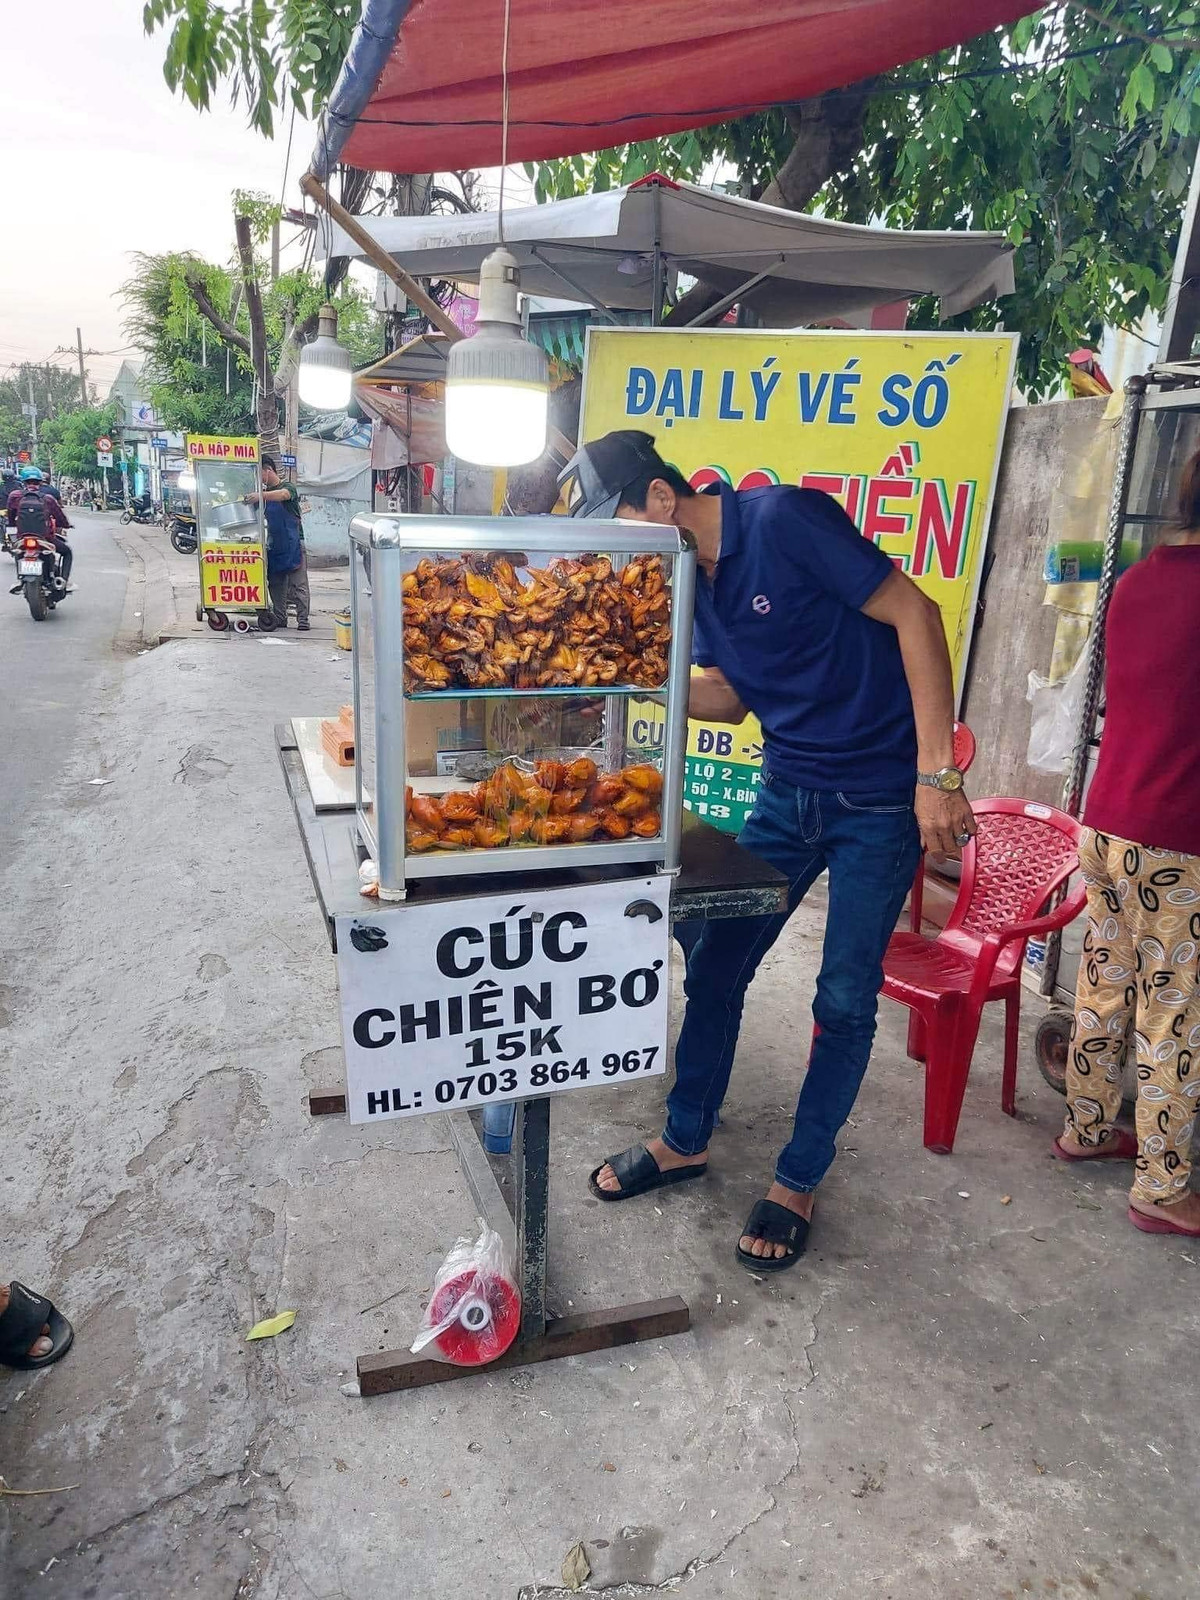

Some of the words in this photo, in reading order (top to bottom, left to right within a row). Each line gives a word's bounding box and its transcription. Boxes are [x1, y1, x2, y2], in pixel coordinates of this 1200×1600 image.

[625, 366, 704, 428] ĐẠI
[718, 356, 782, 422] LÝ
[797, 357, 862, 425] VÉ
[876, 353, 962, 428] SỐ
[190, 440, 205, 455] GÀ
[208, 439, 231, 457] HẤP
[234, 443, 255, 458] MÍA
[207, 585, 261, 603] 150K
[697, 728, 733, 757] ĐB
[694, 762, 715, 781] LỘ
[721, 767, 733, 781] 2
[691, 781, 709, 797] 50
[722, 787, 758, 804] X.BÌN
[435, 904, 589, 979] CÚC
[351, 979, 553, 1049] CHIÊN
[578, 959, 664, 1016] BƠ
[464, 1025, 564, 1068] 15K
[367, 1087, 423, 1115] HL:
[434, 1068, 518, 1104] 0703
[529, 1057, 591, 1087] 864
[601, 1046, 660, 1078] 967
